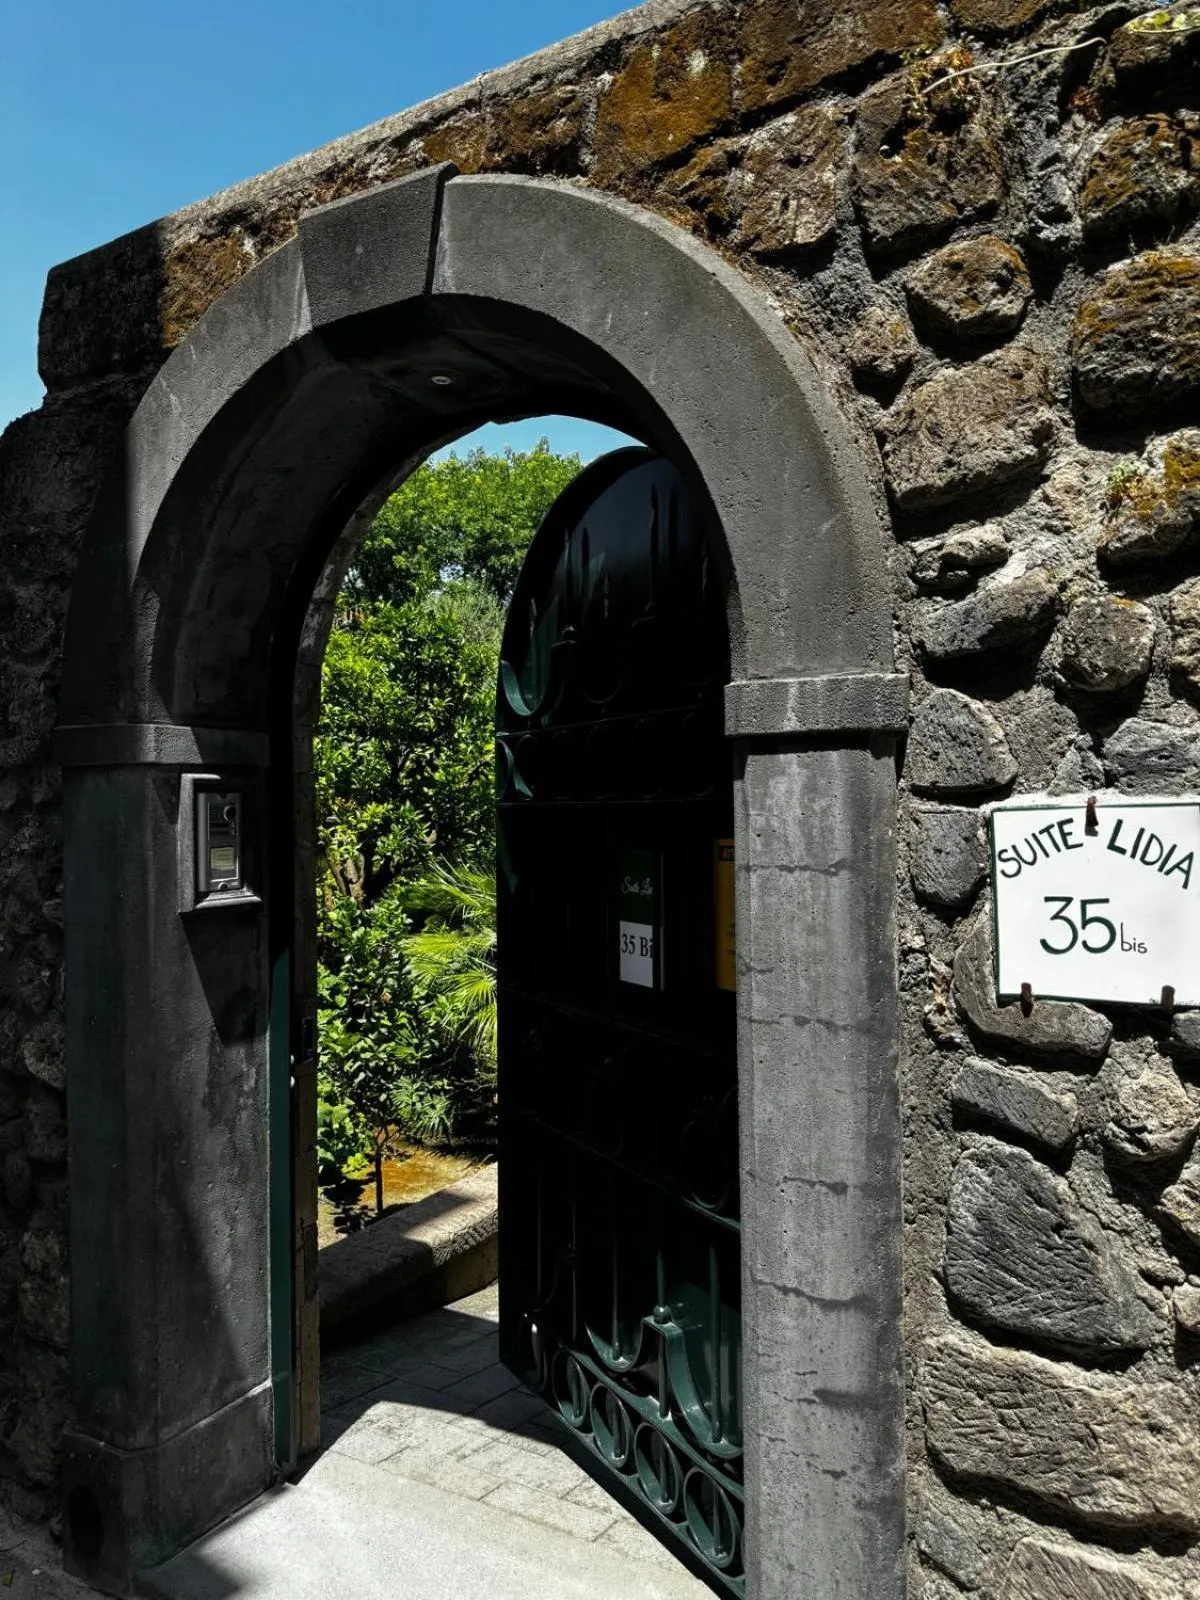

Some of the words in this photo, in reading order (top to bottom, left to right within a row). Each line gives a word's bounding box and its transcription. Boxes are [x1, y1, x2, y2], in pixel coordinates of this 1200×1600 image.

[998, 818, 1083, 878] SUITE
[1106, 819, 1194, 889] LIDIA
[621, 933, 635, 954] 35
[1040, 896, 1116, 954] 35
[1120, 922, 1147, 953] bis
